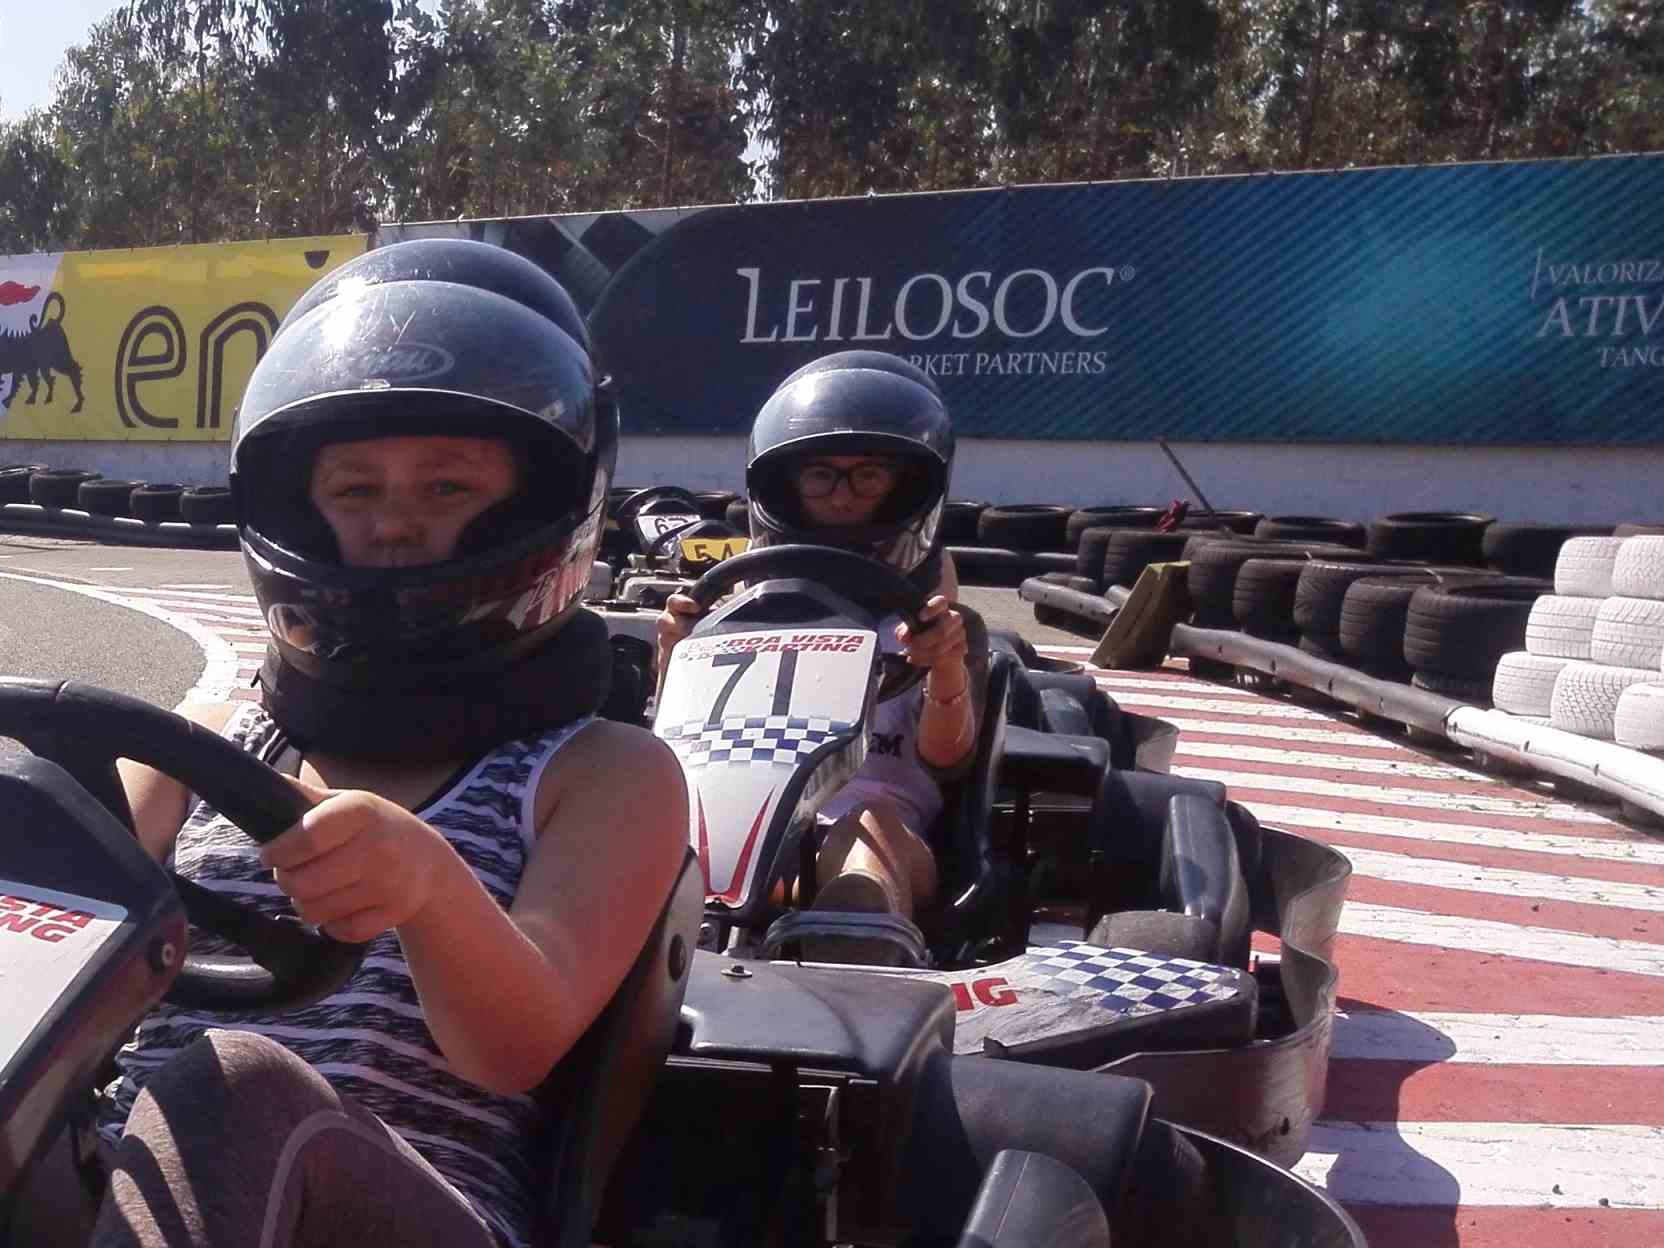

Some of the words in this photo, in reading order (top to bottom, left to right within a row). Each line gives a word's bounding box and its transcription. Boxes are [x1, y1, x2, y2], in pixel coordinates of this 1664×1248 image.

[1548, 260, 1664, 285] VALORIZ
[974, 351, 1107, 376] PARTNERS
[791, 634, 865, 645] VISTA
[707, 650, 798, 725] 71
